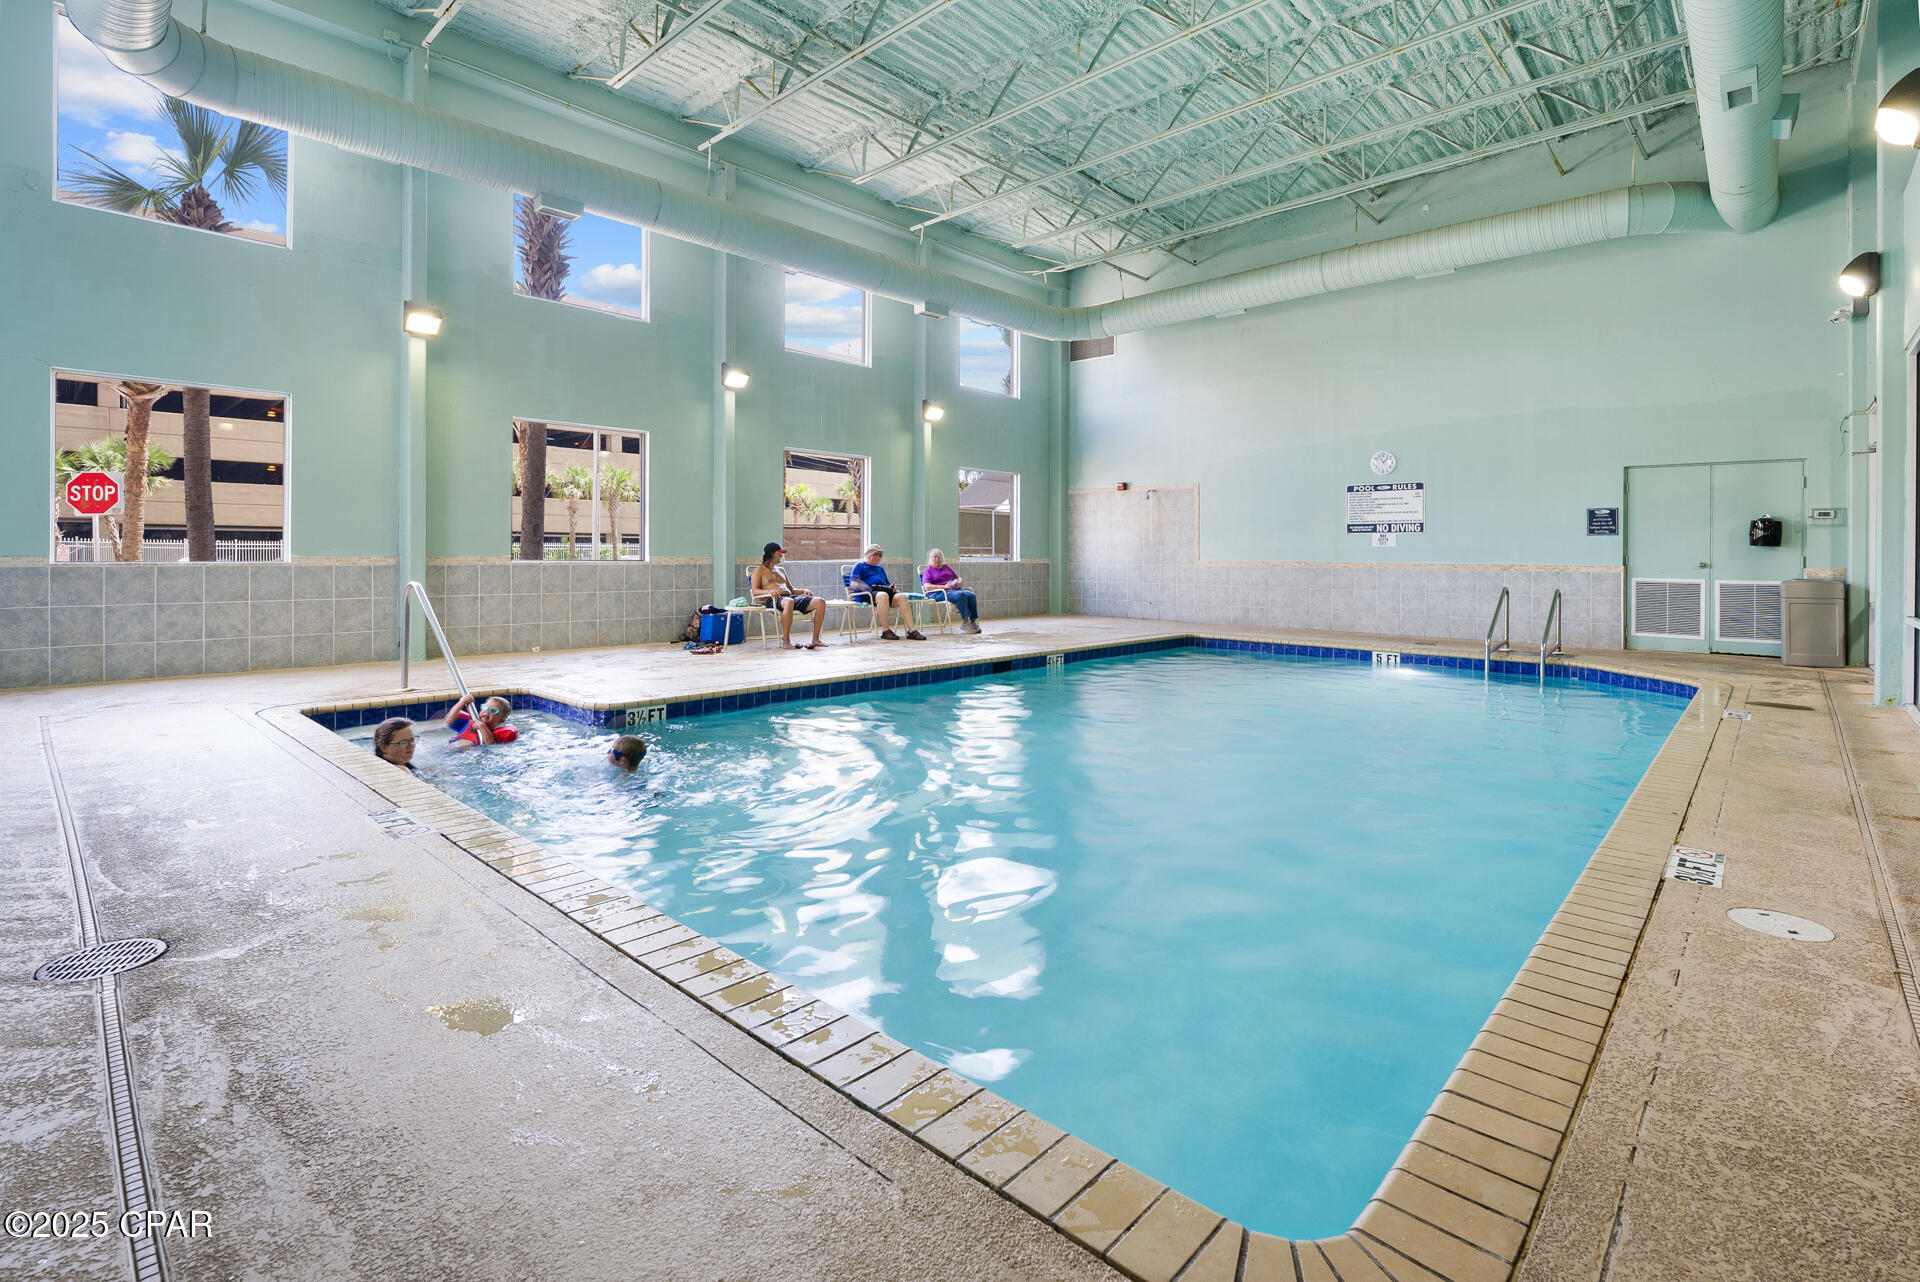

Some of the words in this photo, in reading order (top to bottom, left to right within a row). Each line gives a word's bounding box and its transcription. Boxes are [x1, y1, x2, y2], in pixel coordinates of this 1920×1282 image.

[70, 485, 116, 502] STOP
[1376, 524, 1389, 533] NO
[1391, 523, 1421, 533] DIVING
[1376, 653, 1383, 664] 5
[1386, 654, 1399, 664] FT
[647, 707, 665, 723] FT
